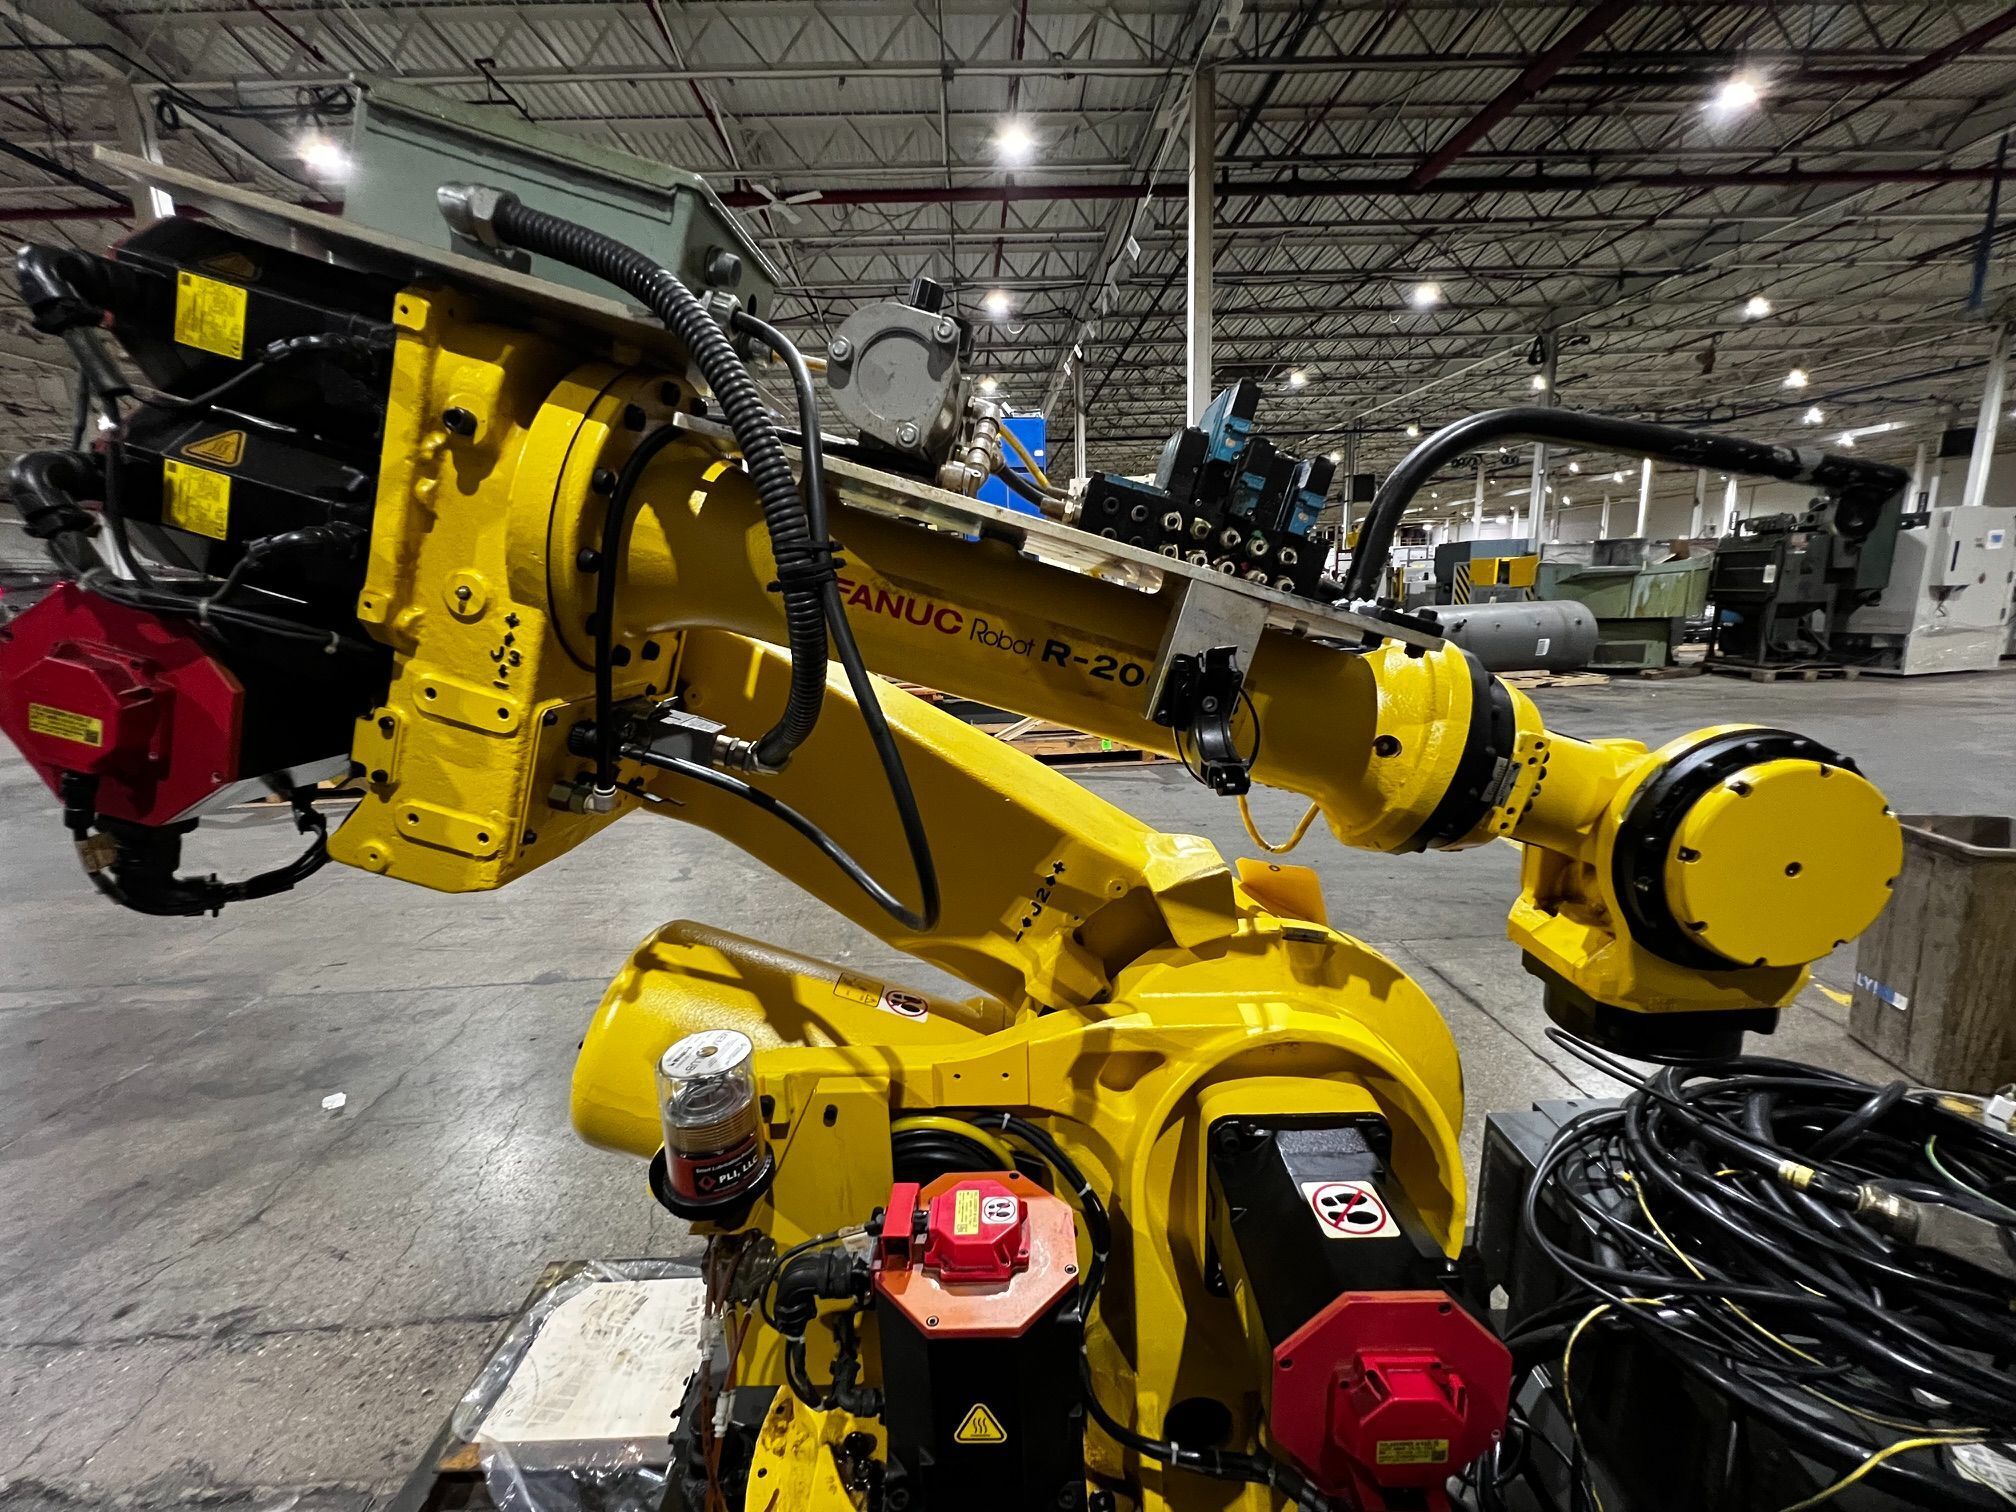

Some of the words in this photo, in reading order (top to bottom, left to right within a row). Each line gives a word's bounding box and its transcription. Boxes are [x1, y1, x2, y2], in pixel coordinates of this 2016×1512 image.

[490, 645, 522, 667] J3
[969, 617, 1036, 657] Robot
[1041, 638, 1150, 687] R-20
[1031, 887, 1051, 916] J2
[742, 1154, 758, 1173] LLC
